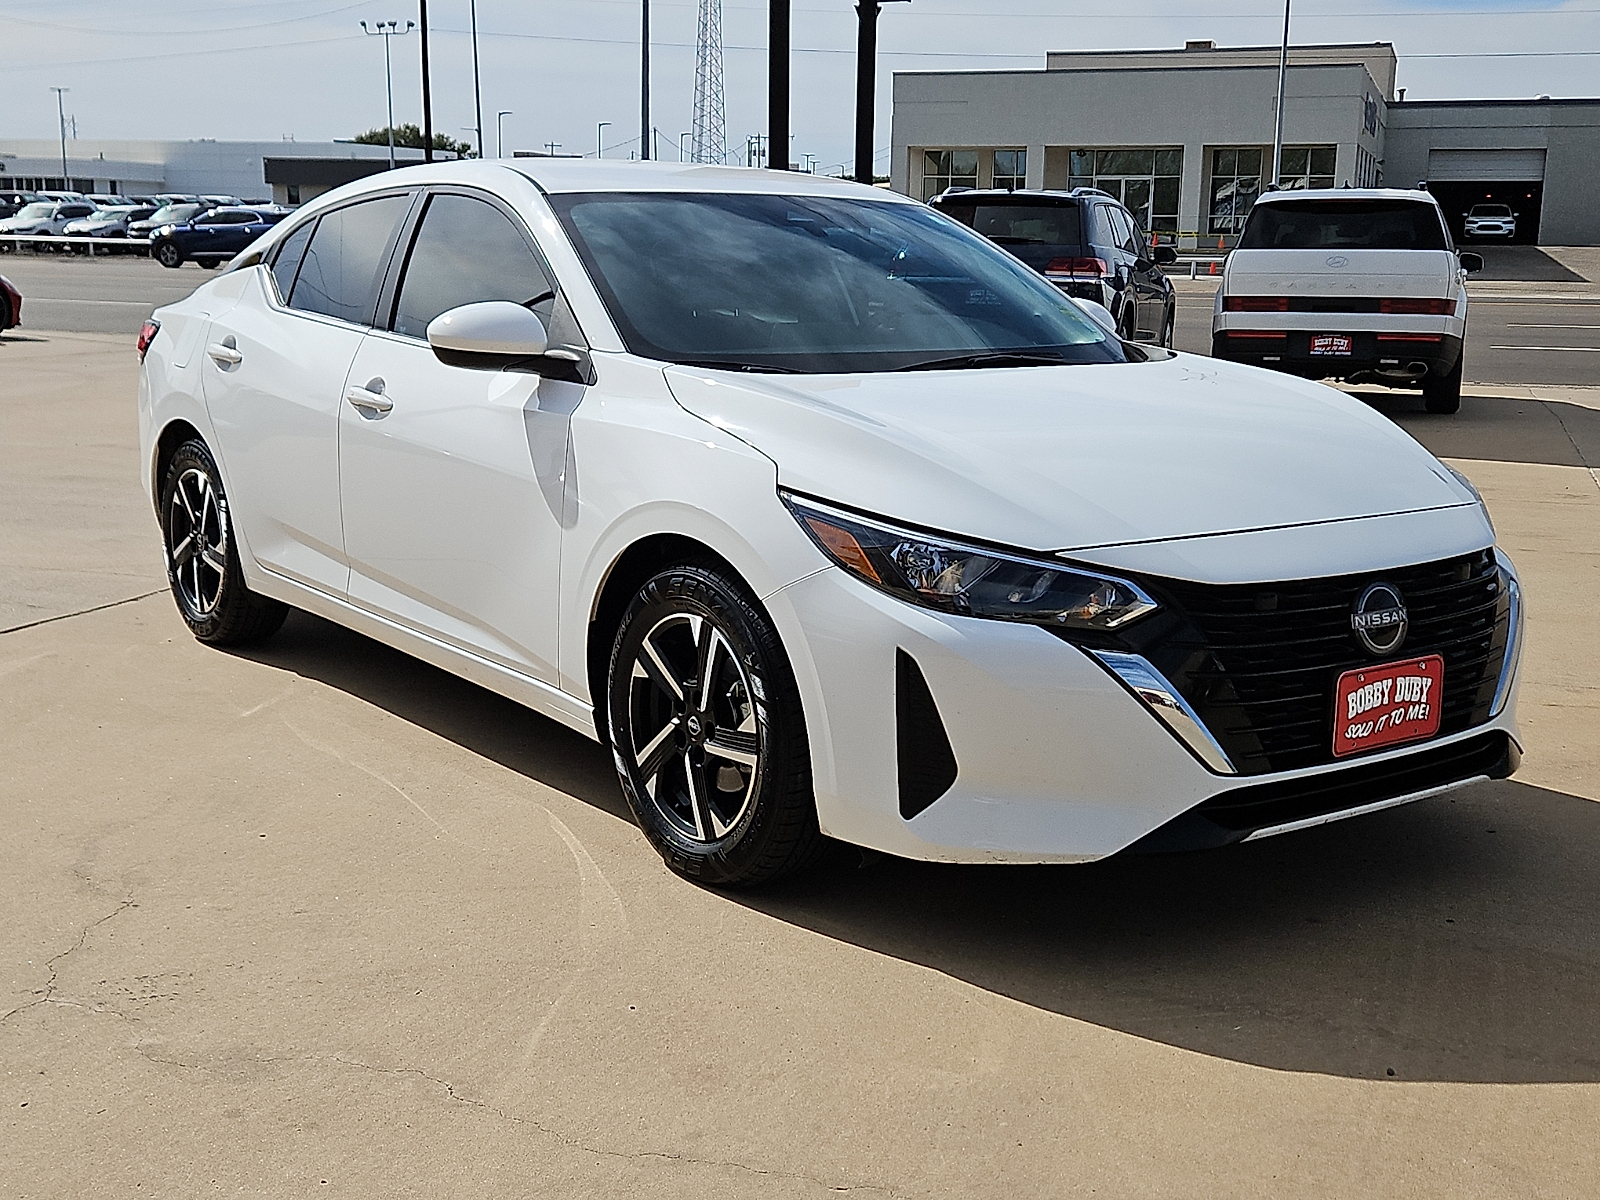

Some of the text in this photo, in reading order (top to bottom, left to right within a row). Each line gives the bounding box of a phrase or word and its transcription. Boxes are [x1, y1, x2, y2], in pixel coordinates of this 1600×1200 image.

[1354, 609, 1407, 627] NISSAN
[1347, 676, 1433, 720] BOBBY DUBY
[1344, 703, 1430, 738] SOLD IT TO ME!
